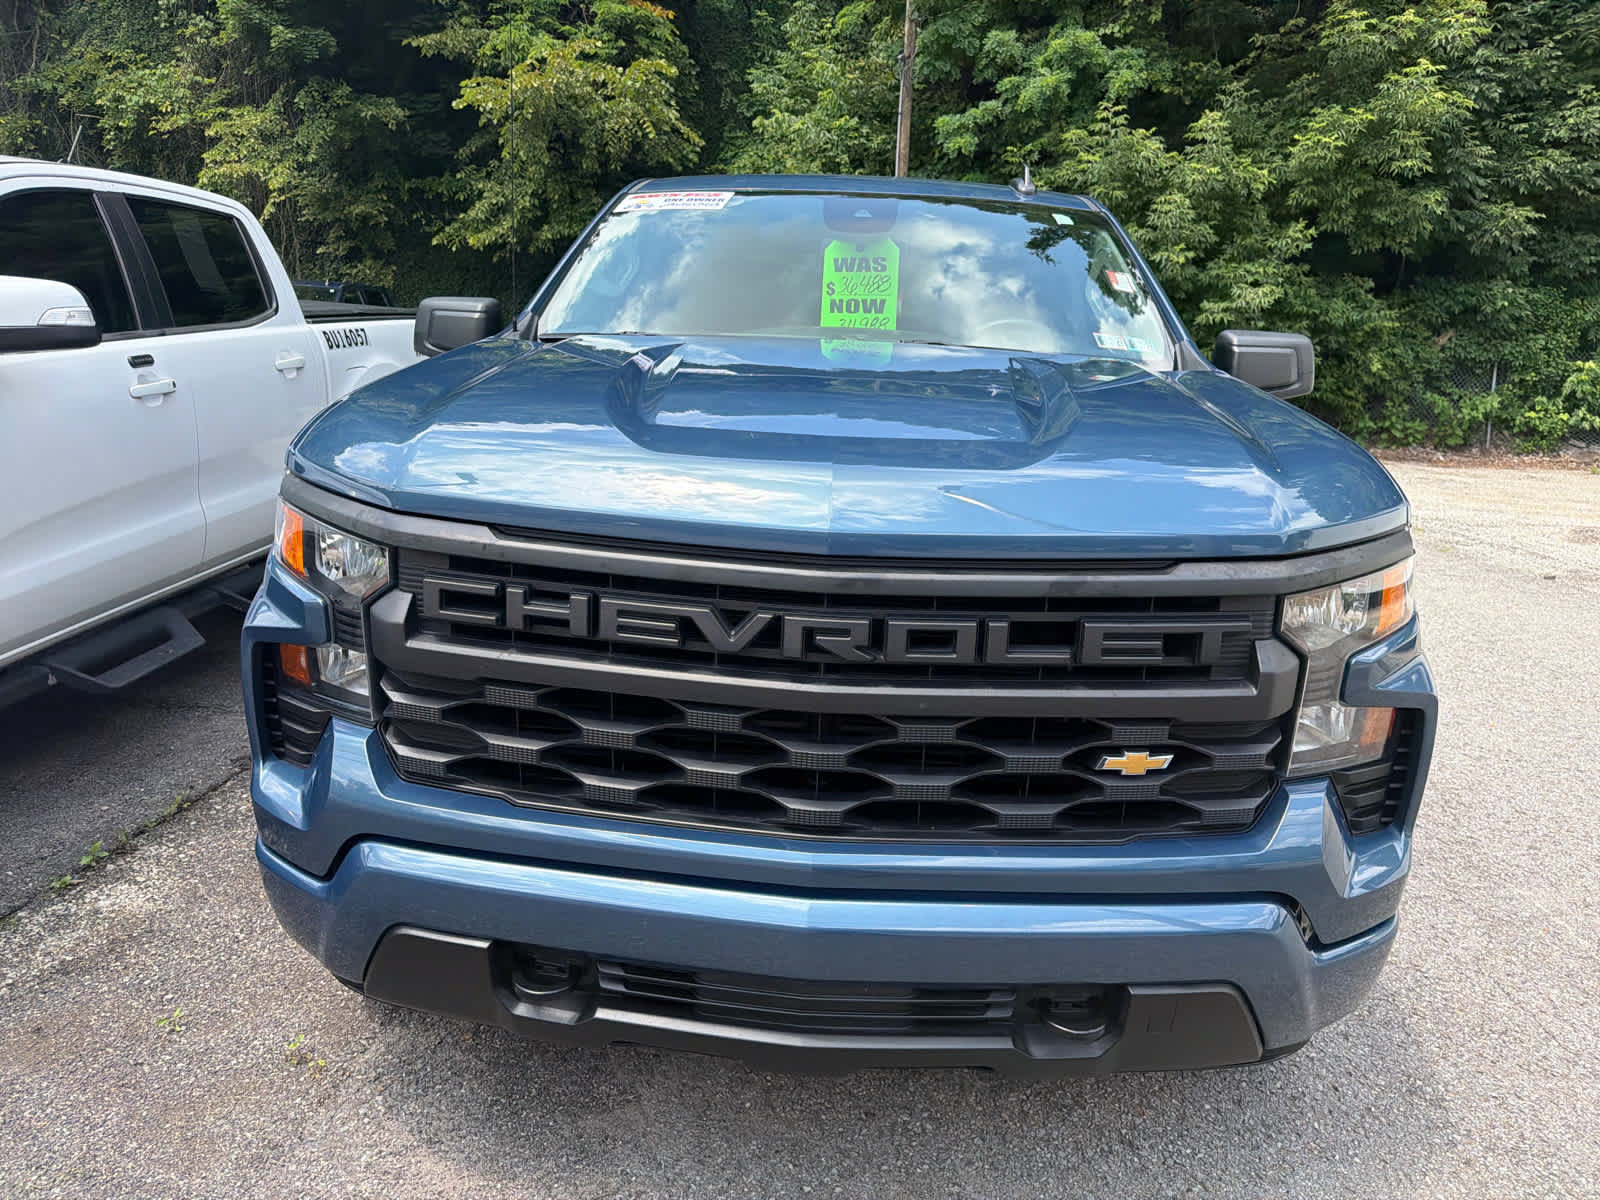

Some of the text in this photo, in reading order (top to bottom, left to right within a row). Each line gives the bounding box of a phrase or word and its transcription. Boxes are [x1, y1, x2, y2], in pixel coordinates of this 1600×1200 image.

[833, 256, 888, 273] WAS
[826, 280, 836, 296] $
[829, 298, 887, 314] NOW
[322, 327, 369, 350] BU16057
[423, 574, 1253, 666] CHEVROLET
